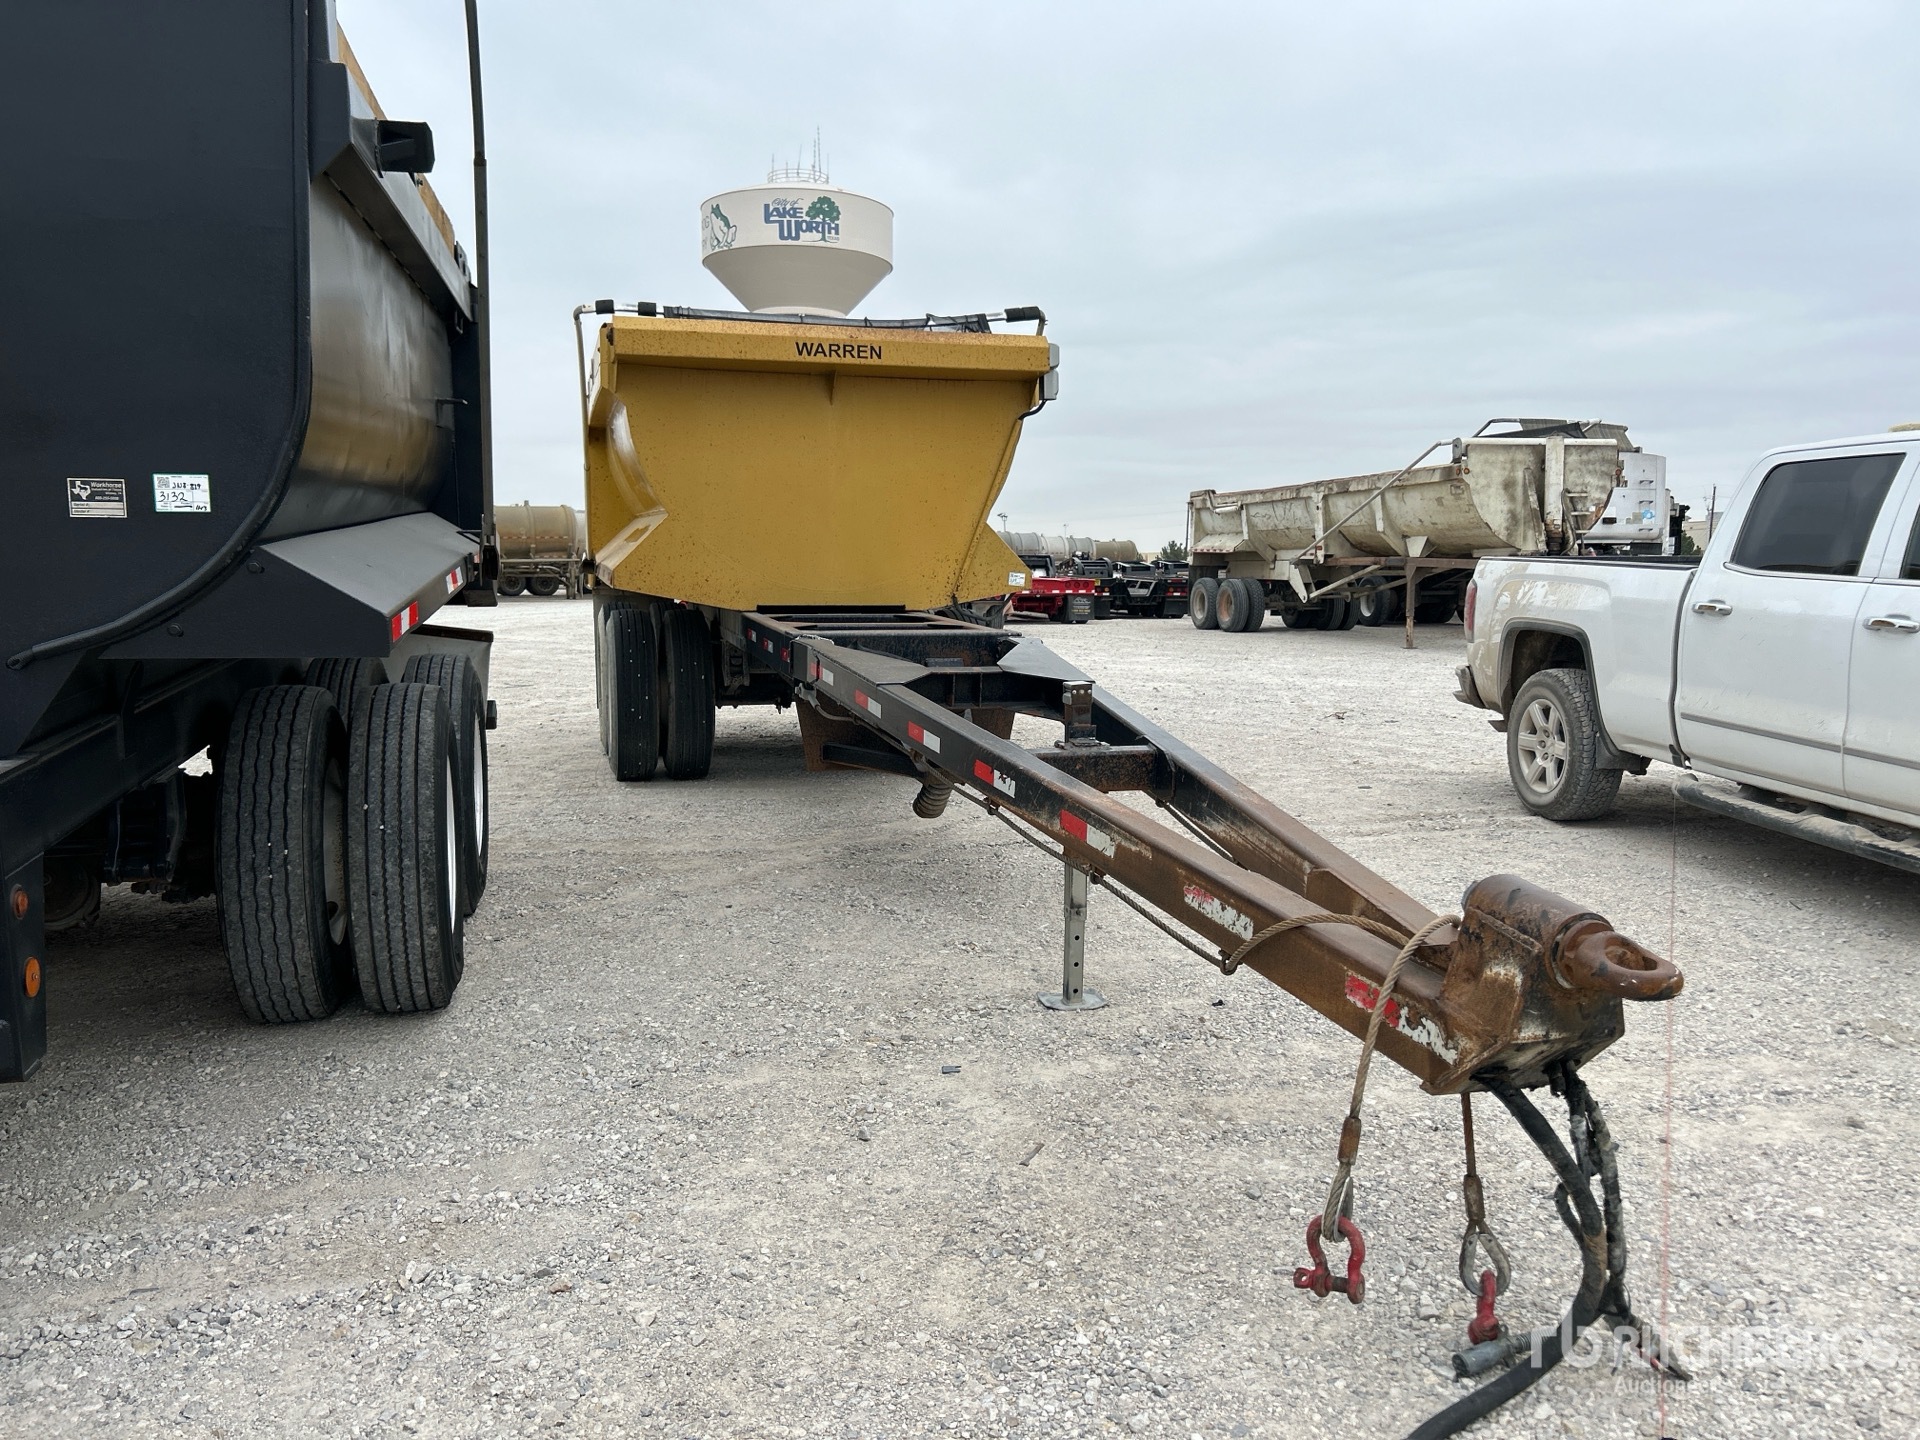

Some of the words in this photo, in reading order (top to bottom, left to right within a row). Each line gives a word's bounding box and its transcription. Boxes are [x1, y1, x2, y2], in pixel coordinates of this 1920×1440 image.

[772, 198, 790, 207] City
[790, 198, 804, 207] of
[764, 204, 804, 225] LAKE
[778, 219, 840, 241] WORTH
[795, 341, 882, 360] WARREN
[158, 491, 188, 503] 3132
